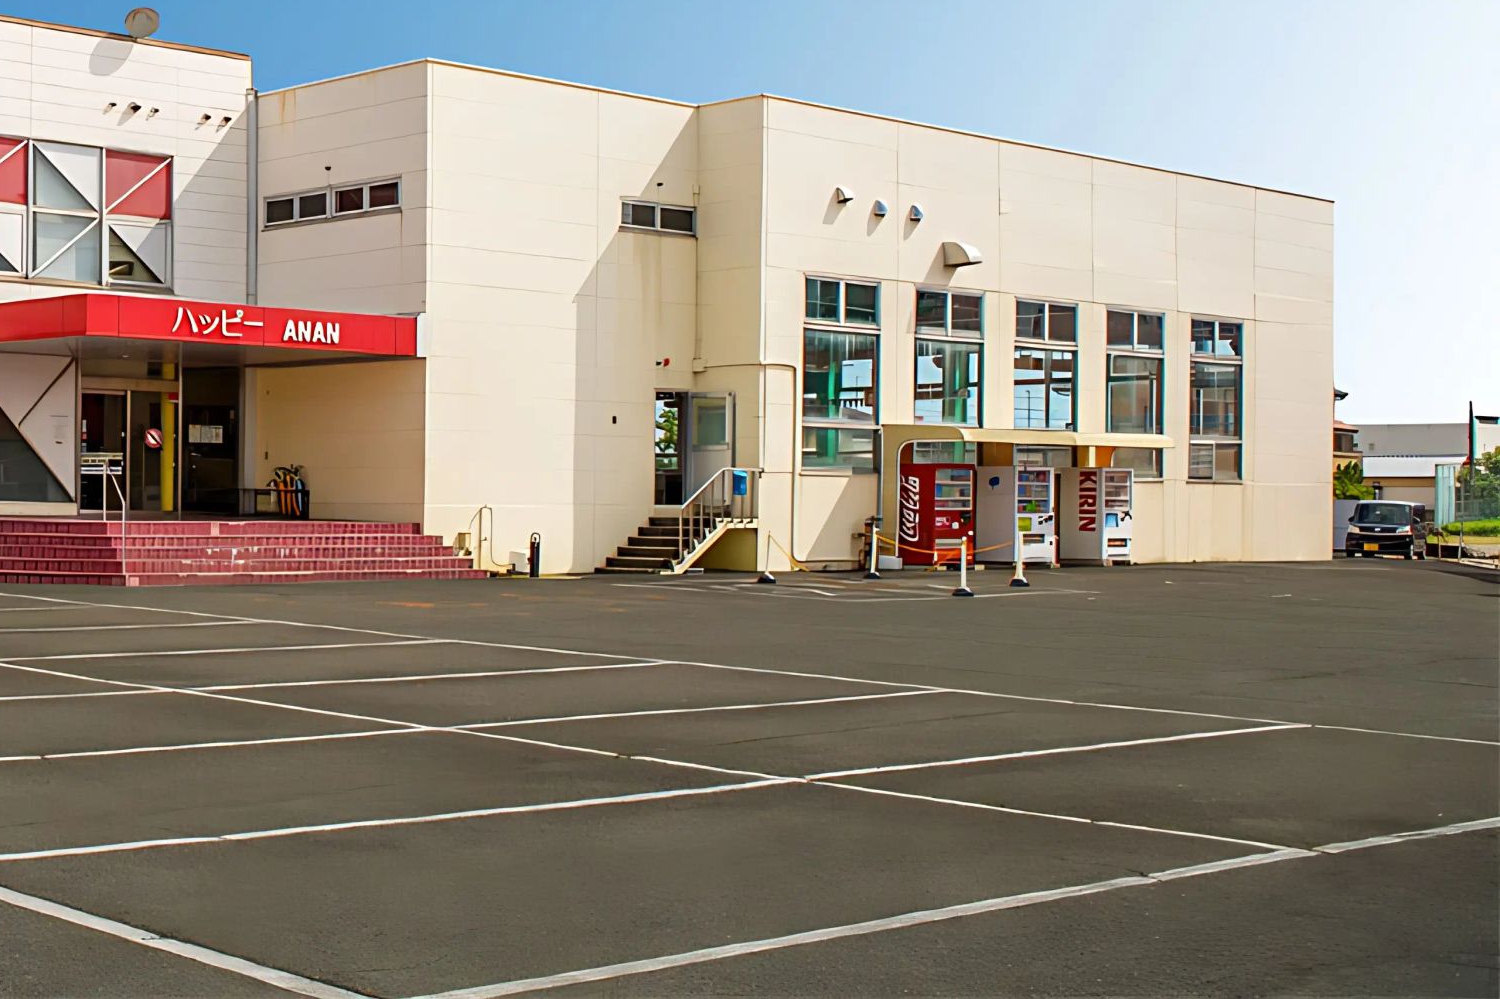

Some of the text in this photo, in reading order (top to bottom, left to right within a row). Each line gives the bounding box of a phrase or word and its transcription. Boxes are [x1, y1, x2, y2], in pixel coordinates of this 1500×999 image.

[171, 306, 340, 345] ハッピー ANAN
[1078, 471, 1097, 532] KIRIN
